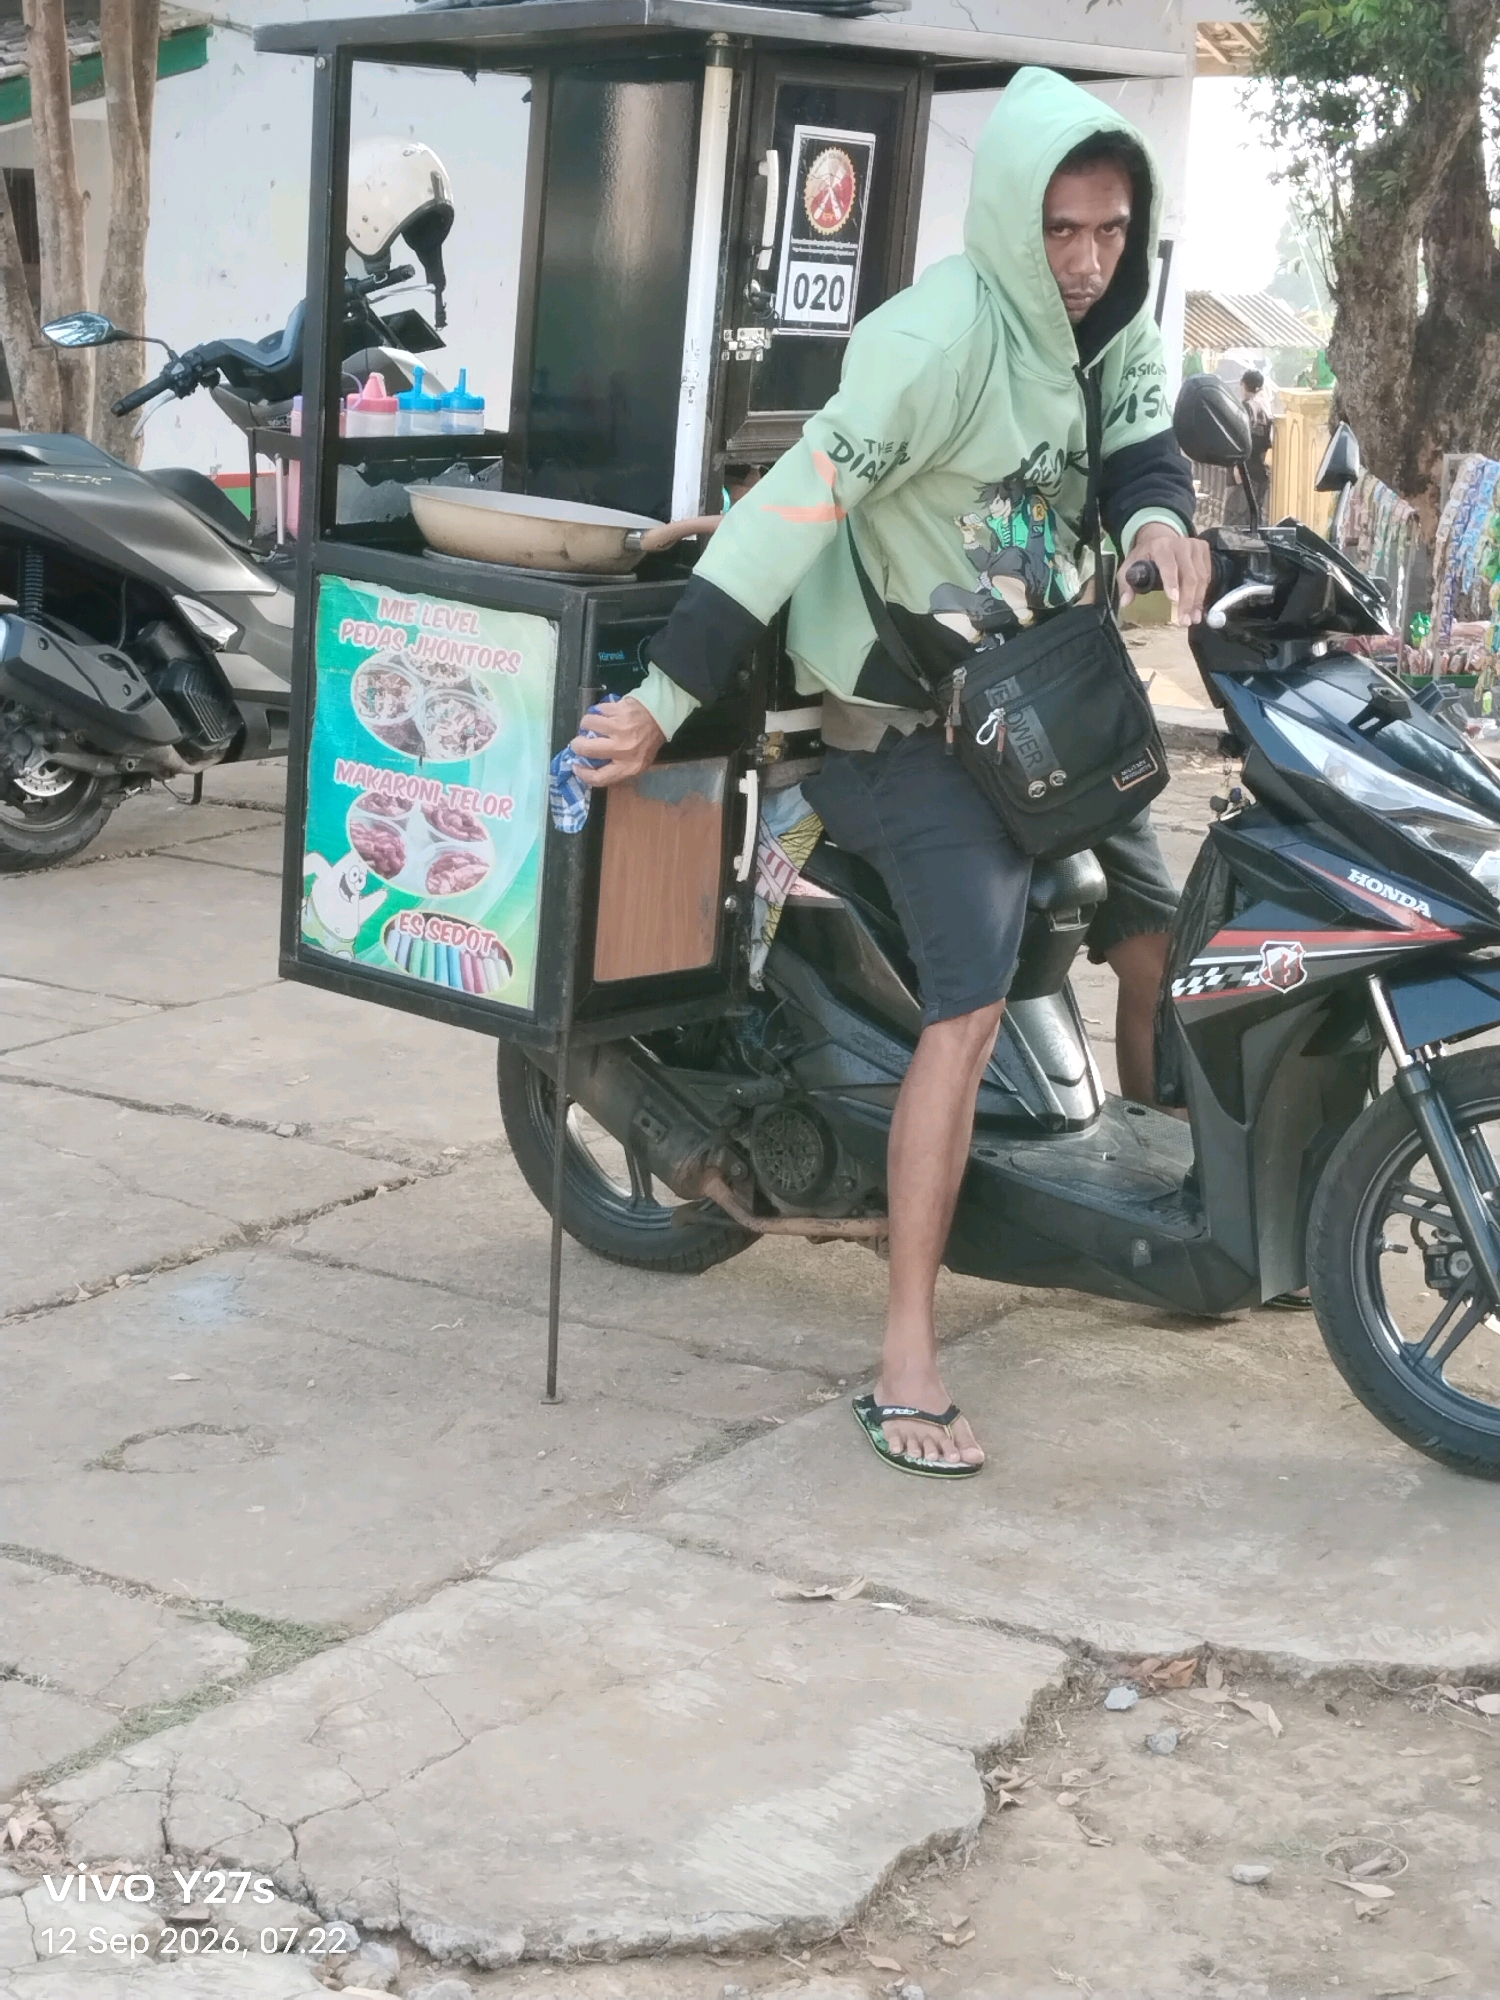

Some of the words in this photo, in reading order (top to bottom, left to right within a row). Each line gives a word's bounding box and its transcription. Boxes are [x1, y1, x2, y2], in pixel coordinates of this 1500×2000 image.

[793, 272, 846, 313] 020
[378, 597, 418, 624] MIE
[422, 604, 479, 635] LEVEL
[341, 620, 407, 652] PEDAS
[410, 636, 522, 674] JHONTORS
[336, 760, 441, 804] MAKARONI
[448, 785, 514, 821] TELOR
[1347, 868, 1432, 918] HONDA
[399, 913, 424, 936] ES
[426, 919, 497, 950] SEDOT
